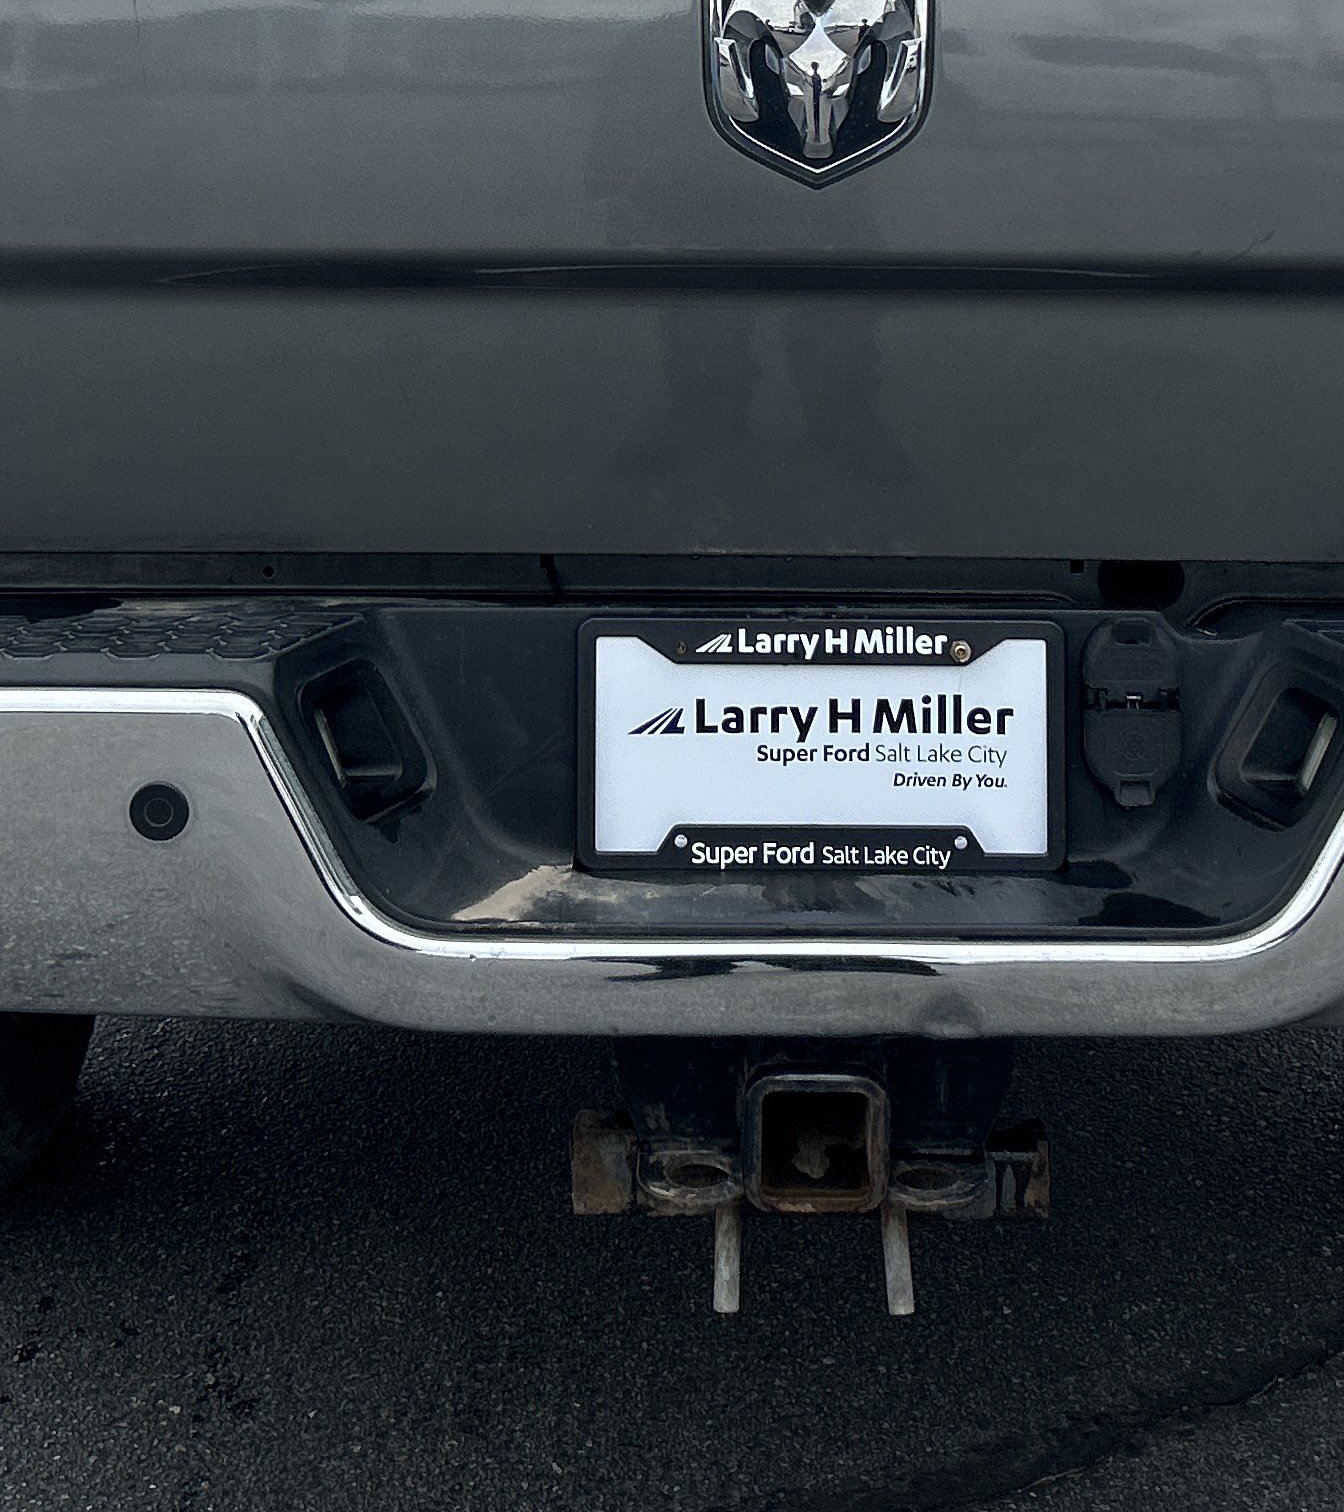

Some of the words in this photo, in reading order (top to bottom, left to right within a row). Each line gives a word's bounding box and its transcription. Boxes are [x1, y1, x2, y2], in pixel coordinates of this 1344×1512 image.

[737, 627, 820, 660] Larry
[824, 628, 848, 655] H
[854, 625, 948, 655] Miller
[695, 697, 818, 743] Larry
[828, 697, 861, 734] H
[872, 693, 1015, 736] Miller
[756, 743, 818, 767] Super
[822, 743, 870, 763] Ford
[874, 743, 911, 763] Salt
[916, 743, 963, 763] Lake
[967, 743, 1008, 769] City
[892, 772, 947, 788] Driven
[951, 773, 973, 791] By
[975, 773, 1008, 788] You.
[690, 841, 758, 870] Super
[762, 841, 815, 865] Ford
[821, 845, 860, 866] Salt
[864, 845, 909, 866] Lake
[912, 845, 952, 870] City
